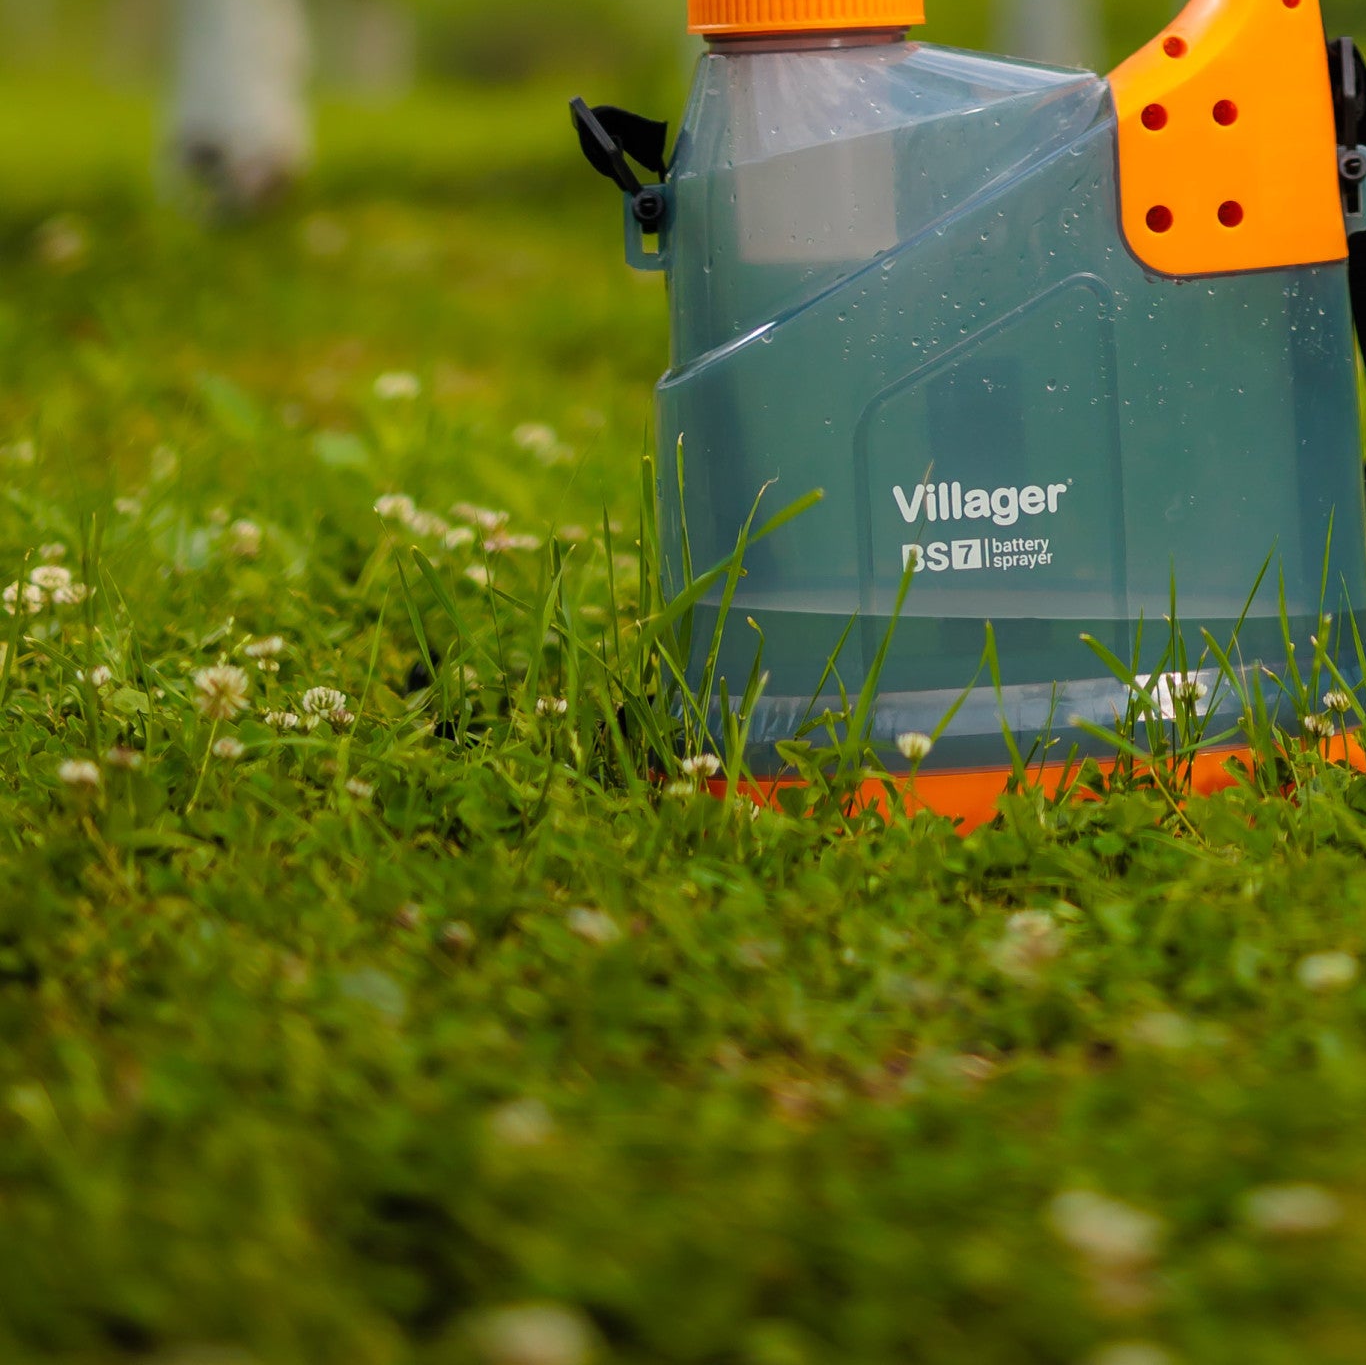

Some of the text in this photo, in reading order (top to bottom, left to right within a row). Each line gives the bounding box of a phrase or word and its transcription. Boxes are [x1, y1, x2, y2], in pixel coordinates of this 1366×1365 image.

[893, 481, 1067, 525] Villager
[992, 538, 1049, 554] battery
[993, 552, 1053, 570] sprayer
